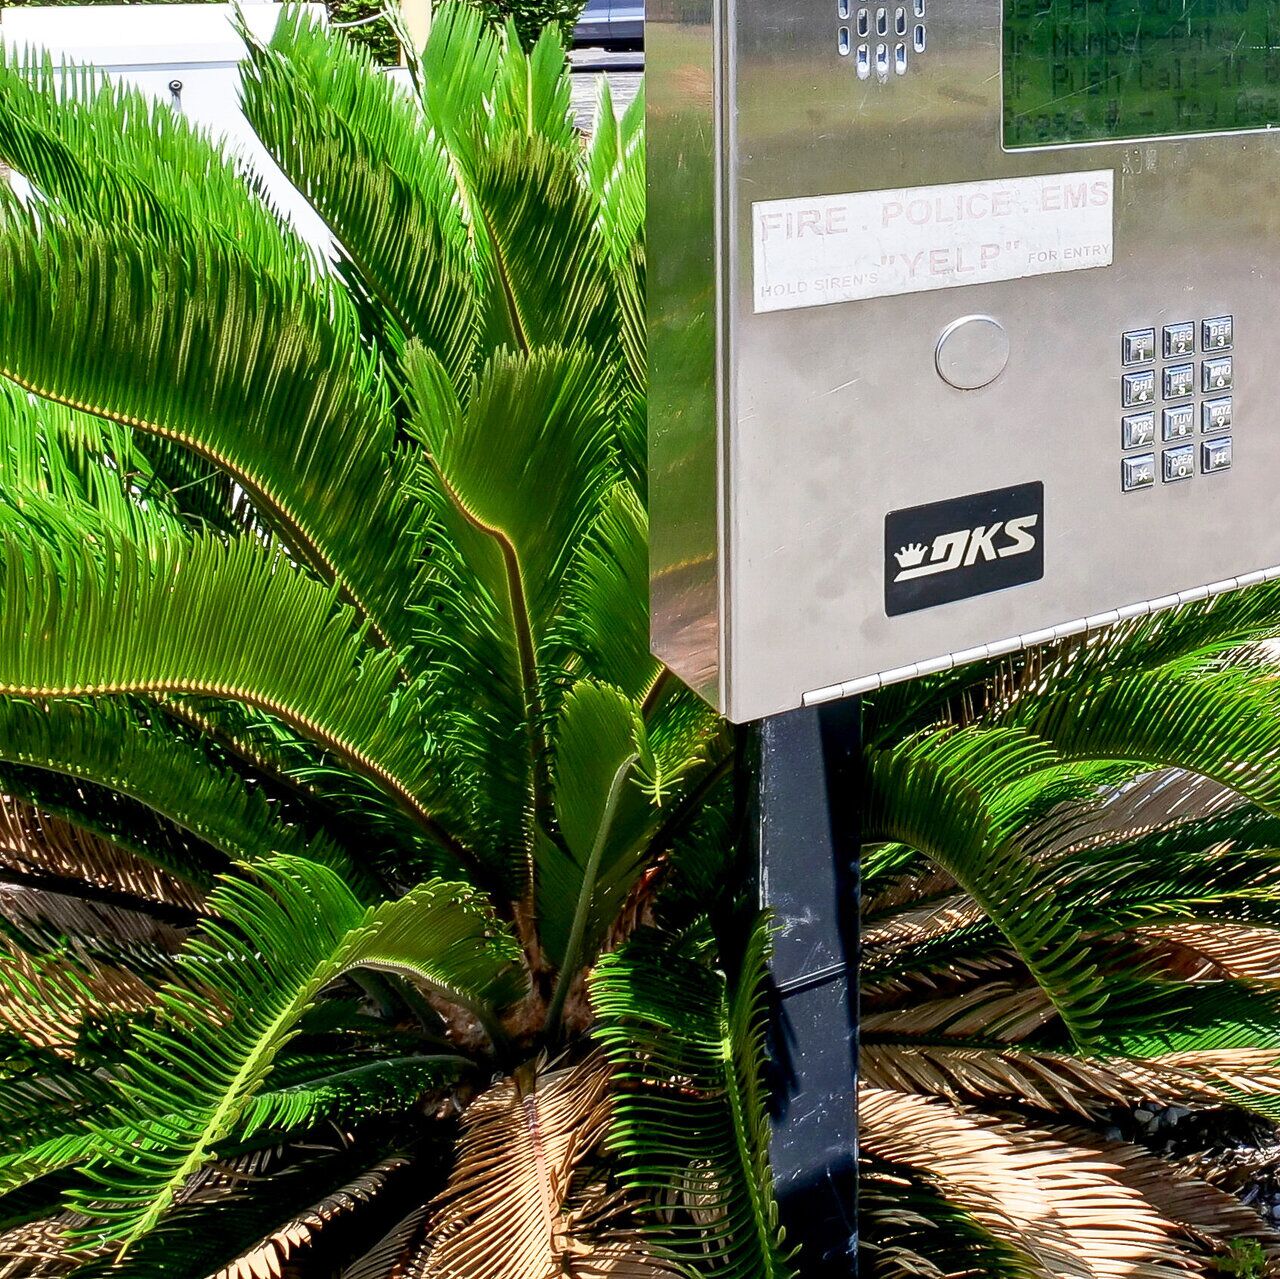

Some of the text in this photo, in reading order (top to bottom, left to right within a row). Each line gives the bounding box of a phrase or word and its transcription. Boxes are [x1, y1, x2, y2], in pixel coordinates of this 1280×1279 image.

[760, 182, 1109, 241] FIRE POLICE EMS
[760, 239, 1110, 298] HOLD SIREN'S "YELP" FOR ENTRY
[1211, 324, 1231, 336] DEF
[1172, 331, 1193, 342] ABC
[1217, 335, 1225, 347] 3
[1178, 342, 1186, 353] 2
[1138, 348, 1145, 360] 1
[1211, 365, 1231, 377] MNO
[1173, 372, 1192, 384] JKL
[1217, 376, 1225, 387] 6
[1132, 378, 1153, 392] GHI
[1178, 384, 1186, 395] 5
[1139, 391, 1148, 402] 4
[1212, 406, 1232, 417] WXYZ
[1173, 413, 1192, 425] TUV
[1217, 416, 1225, 427] 9
[1179, 424, 1187, 435] 8
[1138, 433, 1146, 445] 7
[893, 513, 1039, 583] DKS
